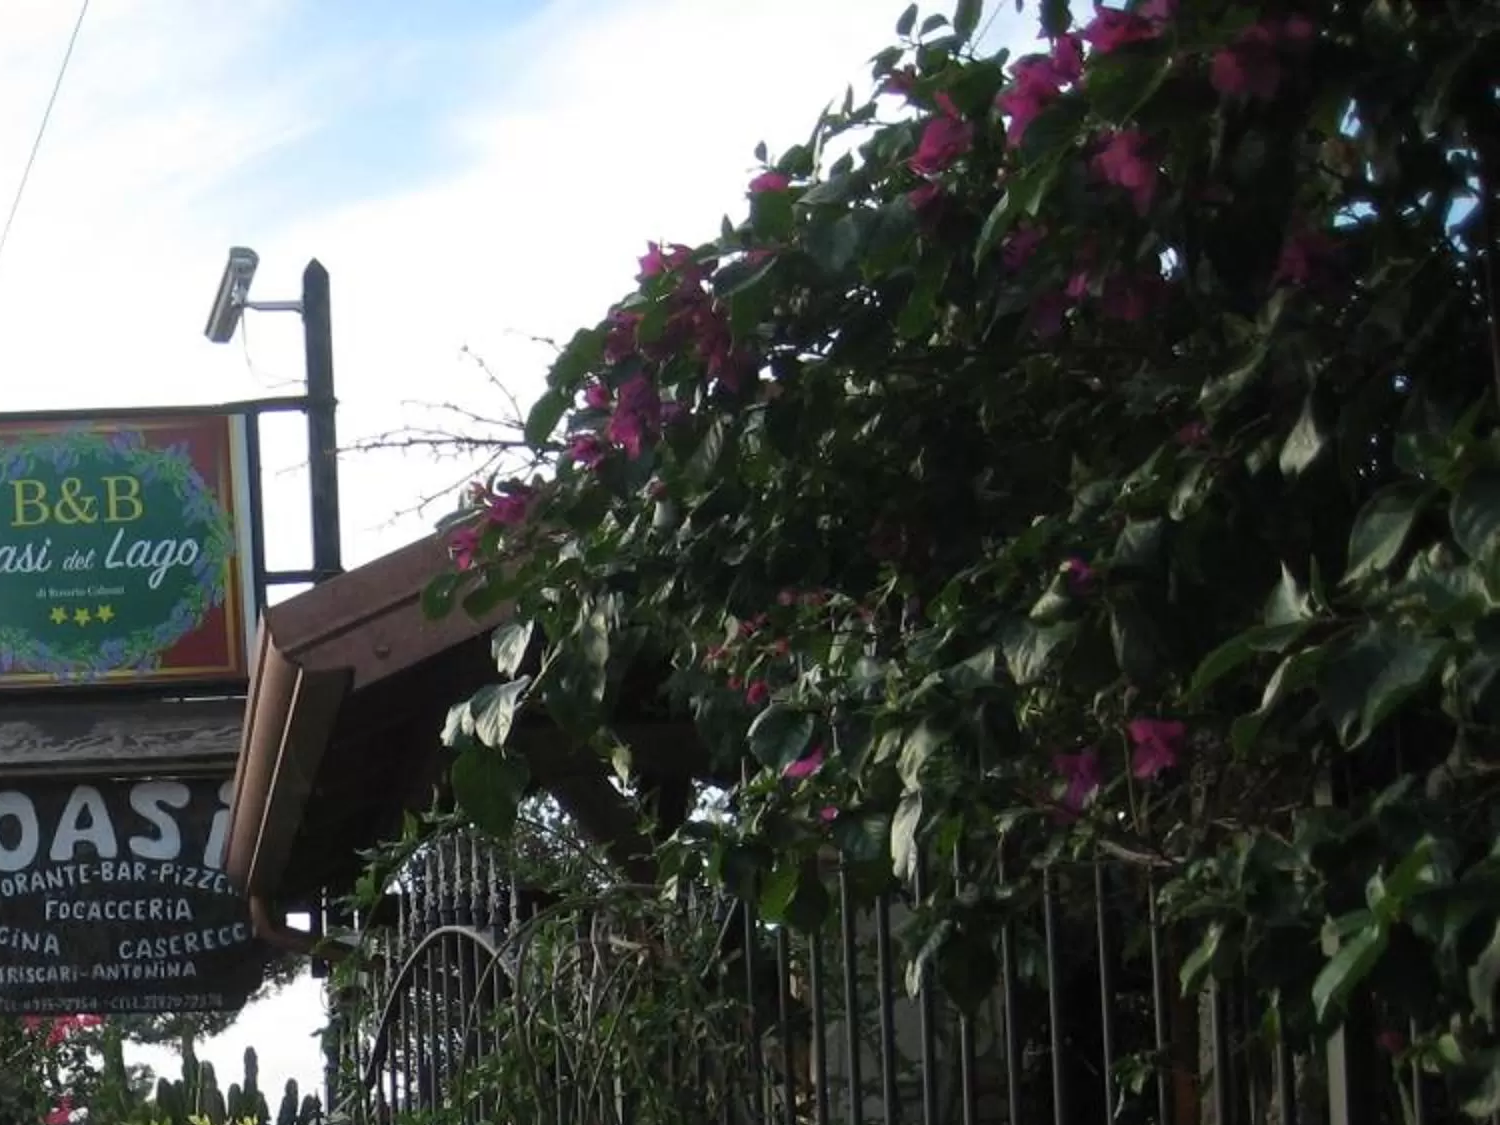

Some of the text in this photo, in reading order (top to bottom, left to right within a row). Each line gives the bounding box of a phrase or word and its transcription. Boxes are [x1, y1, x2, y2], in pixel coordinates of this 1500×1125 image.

[8, 475, 145, 528] B&B
[62, 549, 98, 571] del
[104, 527, 200, 590] Lago
